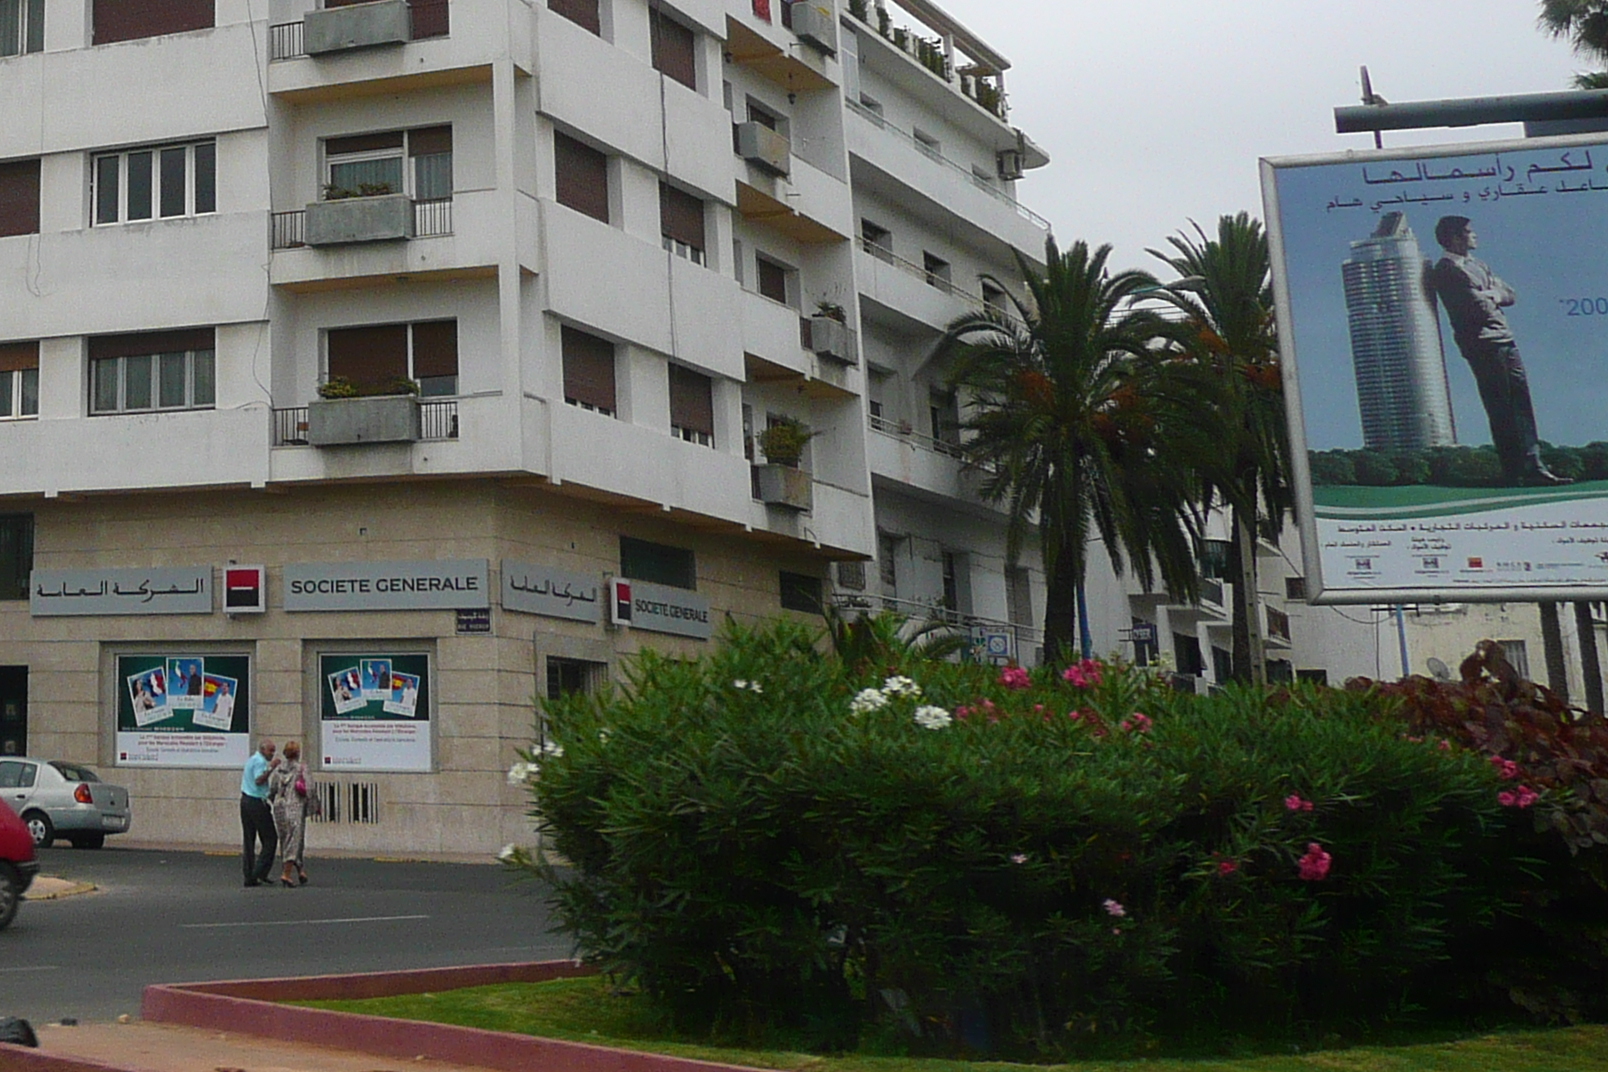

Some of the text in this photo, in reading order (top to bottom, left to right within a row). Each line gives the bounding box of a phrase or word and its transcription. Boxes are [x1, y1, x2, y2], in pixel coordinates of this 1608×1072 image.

[1527, 150, 1593, 183] لكم
[1370, 190, 1454, 213] سياحي
[1462, 191, 1470, 203] و
[1478, 183, 1548, 201] عقاري
[36, 578, 204, 603] الشركة العامة
[291, 577, 478, 594] SOCIETE GENERALE
[635, 598, 708, 624] SOCIETE GENERALE
